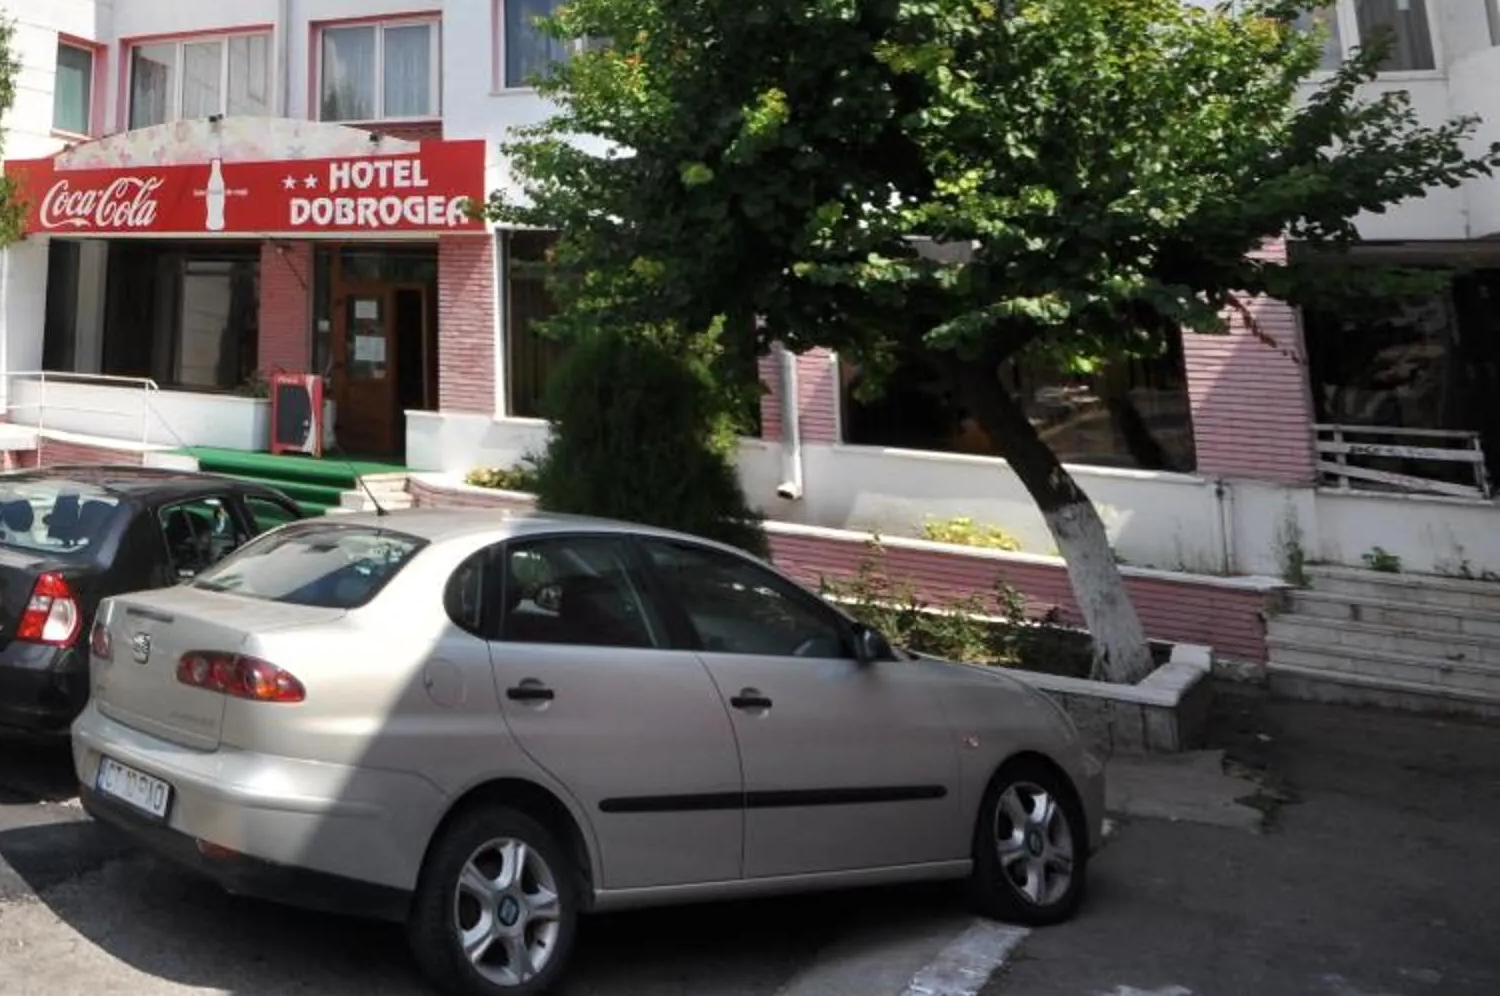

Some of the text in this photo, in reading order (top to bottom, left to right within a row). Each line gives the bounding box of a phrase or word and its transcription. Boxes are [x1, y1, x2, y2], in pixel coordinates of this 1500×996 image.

[329, 159, 428, 193] HOTEL
[40, 176, 165, 228] Coca-Cola
[290, 195, 469, 228] DOBROGEA
